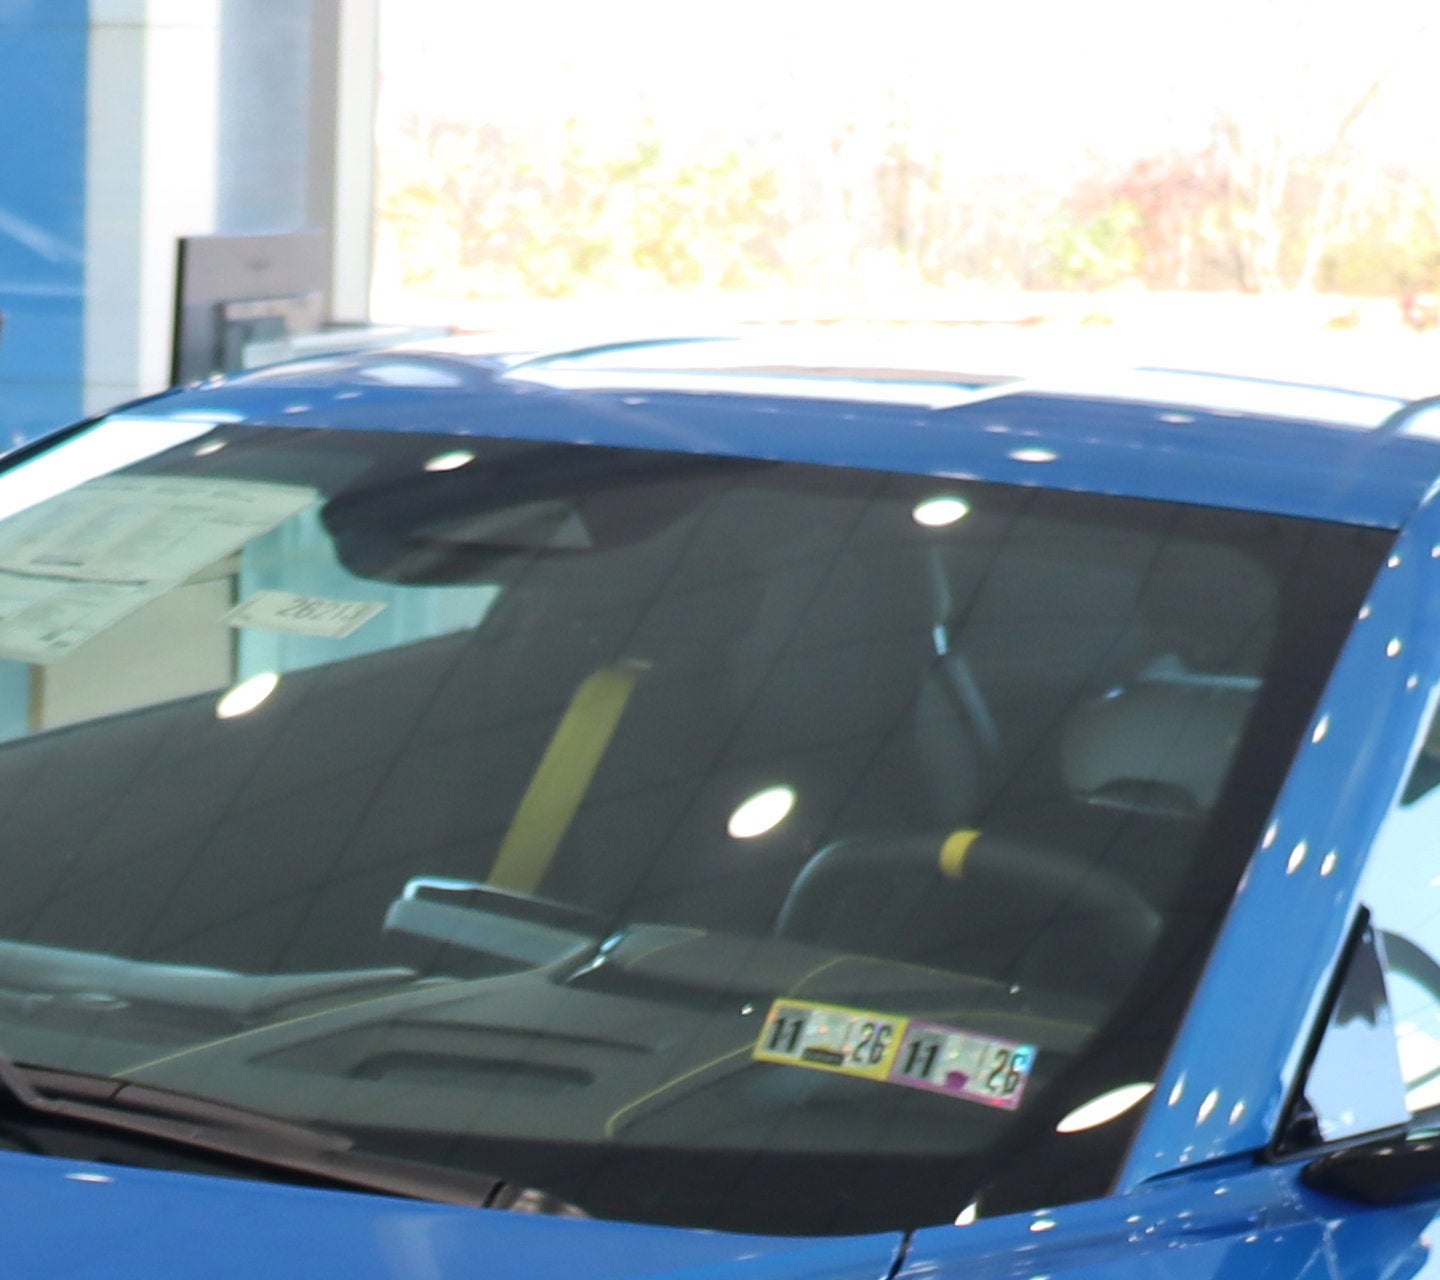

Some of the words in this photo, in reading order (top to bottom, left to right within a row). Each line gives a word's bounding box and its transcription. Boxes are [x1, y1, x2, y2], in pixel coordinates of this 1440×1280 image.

[768, 1017, 803, 1053] 11
[852, 1022, 892, 1065] 26
[904, 1040, 940, 1079] 11
